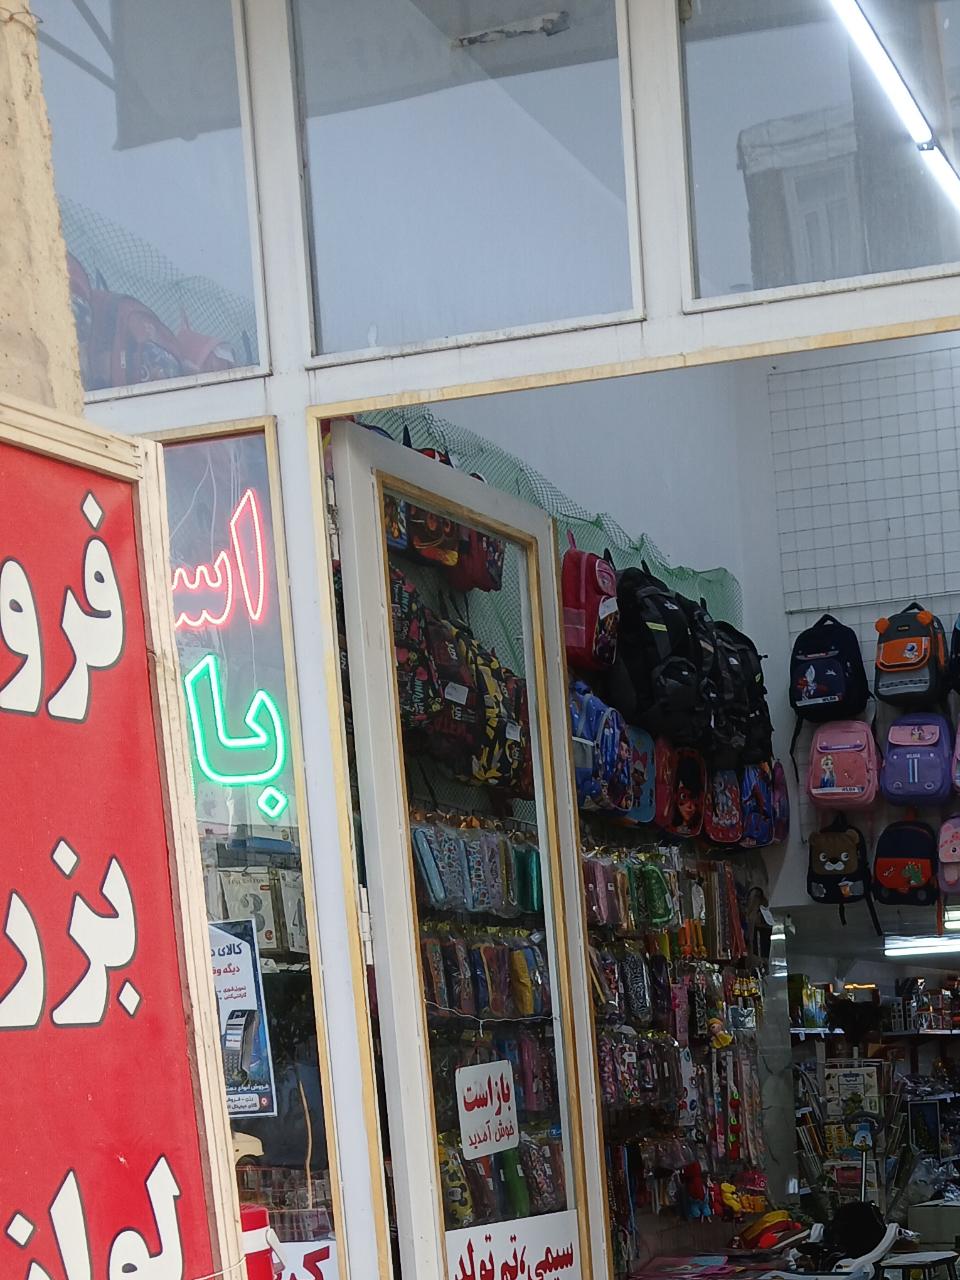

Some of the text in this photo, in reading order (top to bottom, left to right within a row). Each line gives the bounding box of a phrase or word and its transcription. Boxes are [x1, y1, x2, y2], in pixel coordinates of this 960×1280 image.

[0, 488, 127, 724] فرو
[172, 487, 266, 628] اس
[184, 652, 288, 819] با
[0, 836, 140, 1029] بزر
[463, 1072, 511, 1116] باز است
[469, 1120, 514, 1149] خوش آمدید
